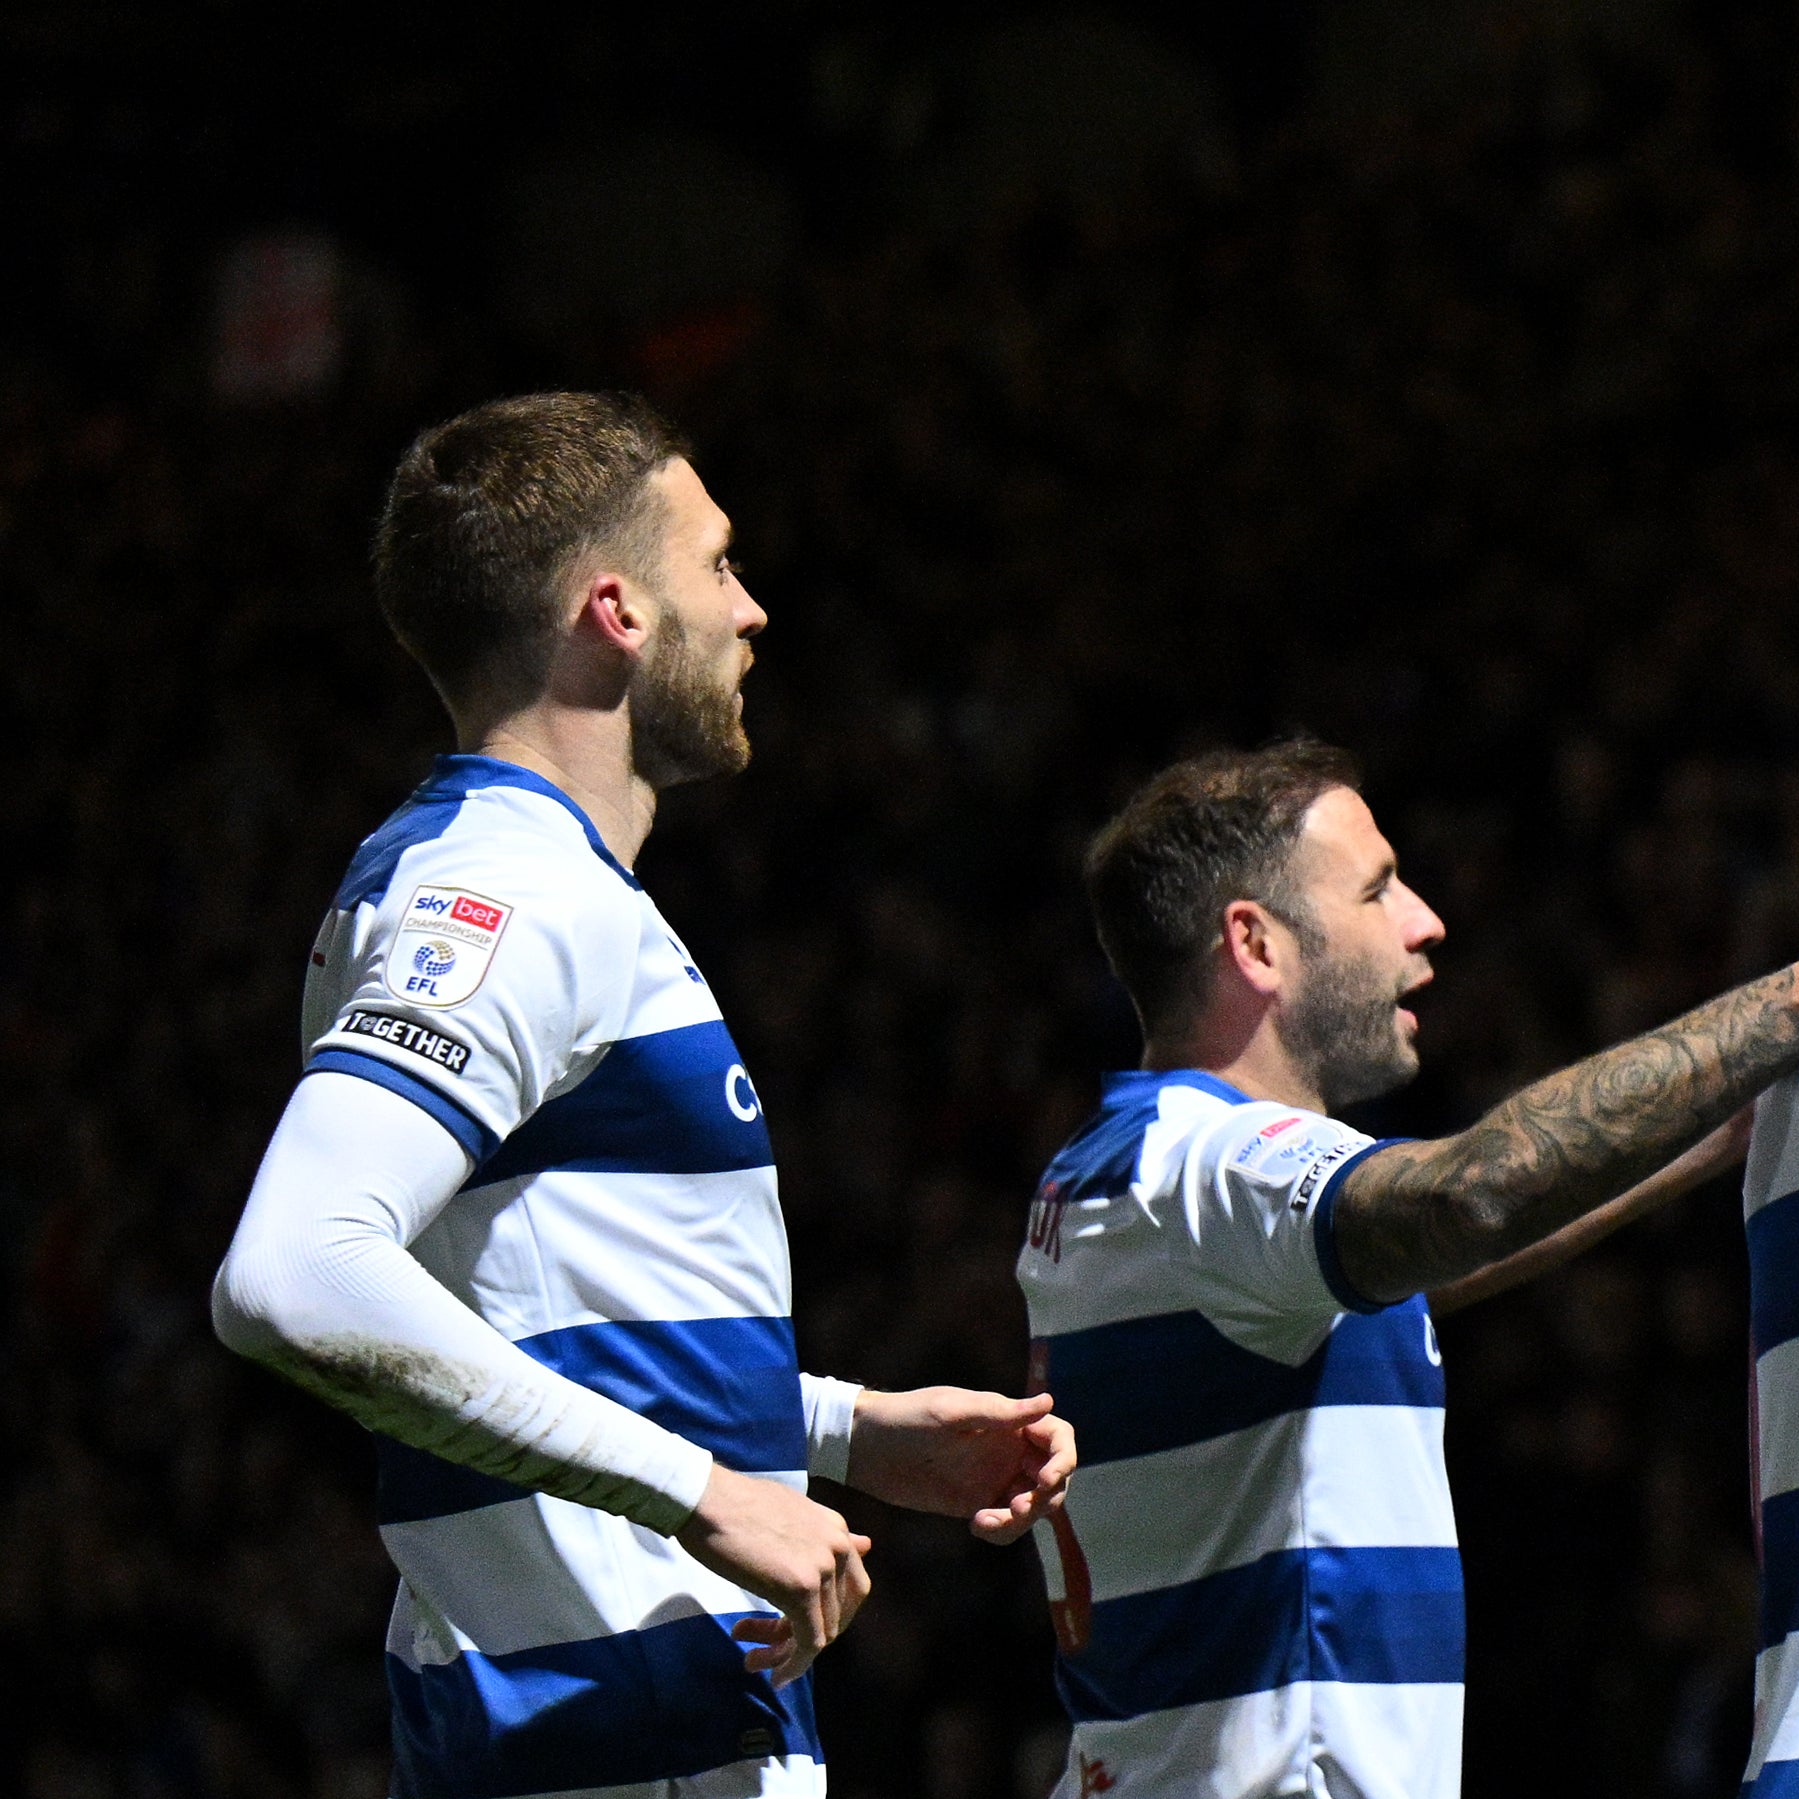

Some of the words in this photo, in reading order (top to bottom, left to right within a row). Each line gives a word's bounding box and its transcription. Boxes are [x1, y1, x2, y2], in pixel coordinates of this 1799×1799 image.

[415, 895, 453, 916] sky
[457, 899, 498, 927] bet
[405, 918, 493, 945] CHAMPIONSHIP
[406, 976, 439, 997] EFL
